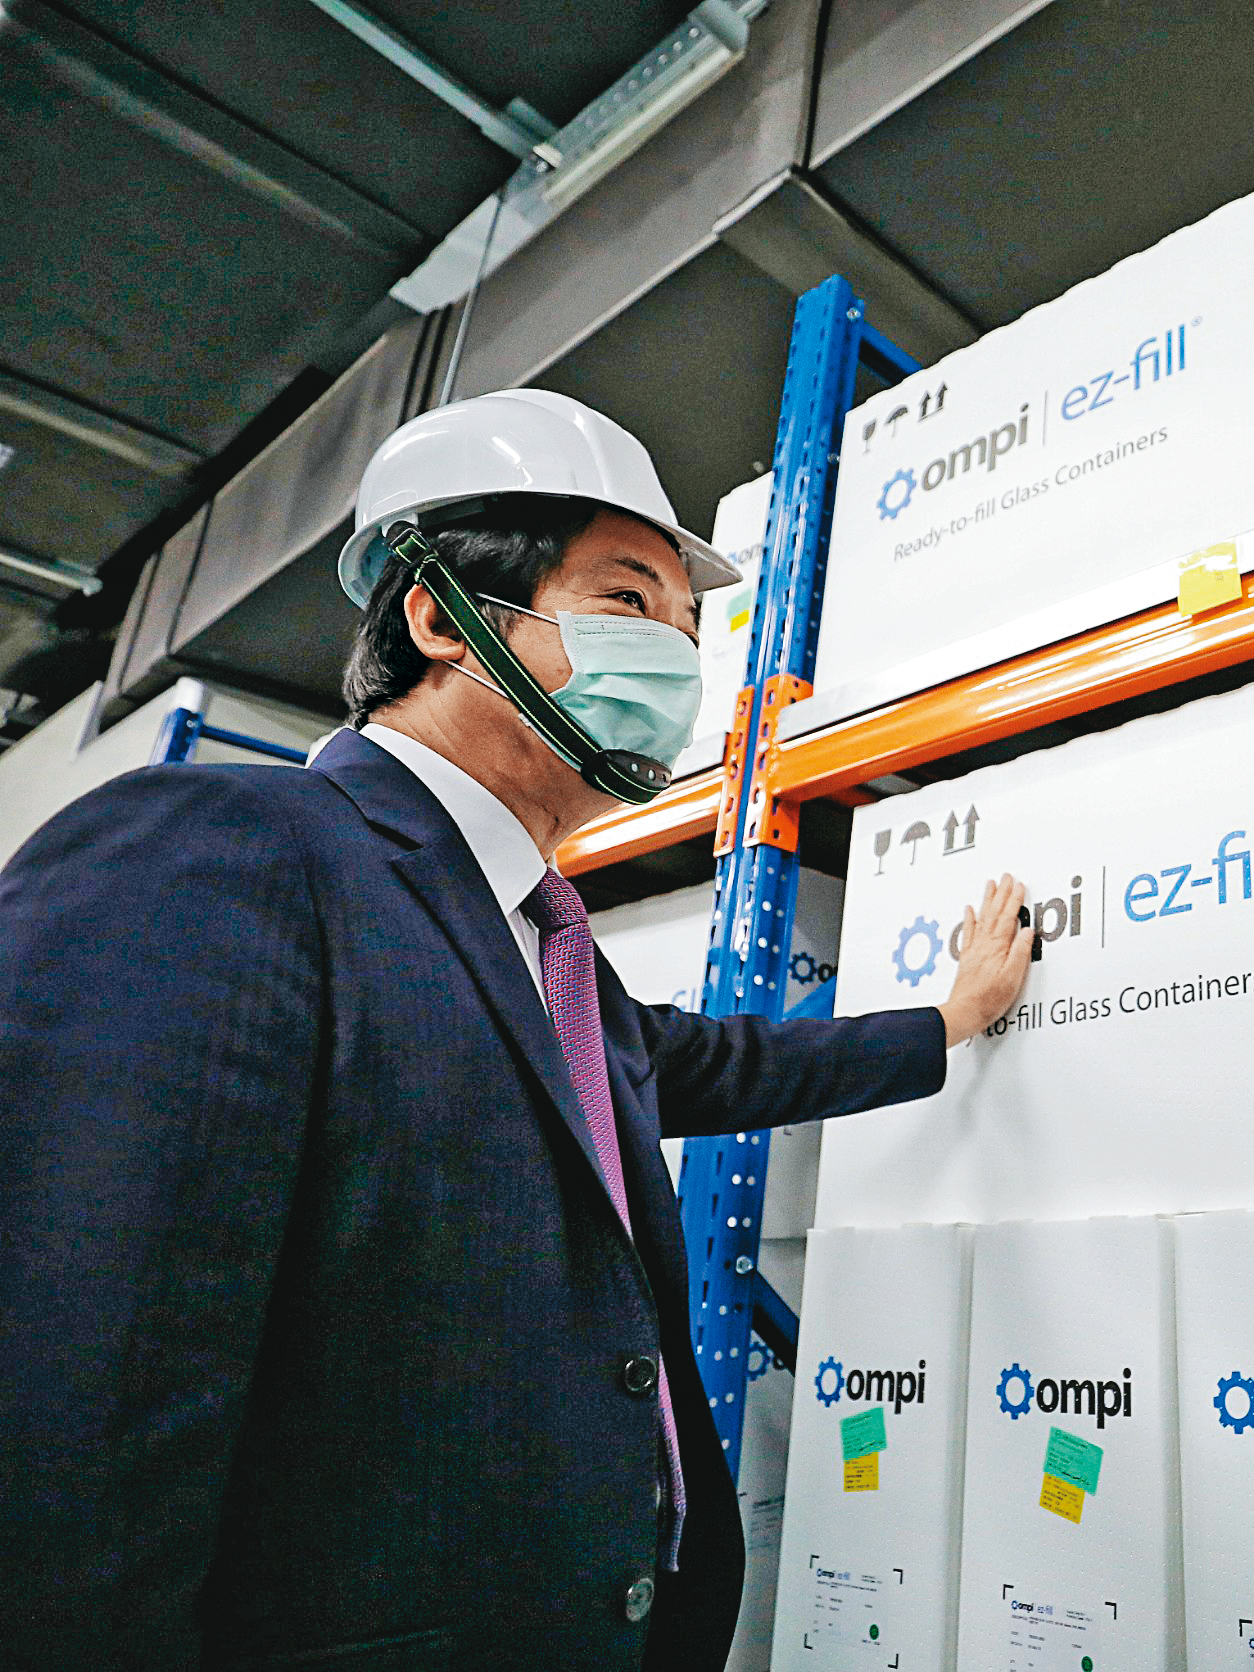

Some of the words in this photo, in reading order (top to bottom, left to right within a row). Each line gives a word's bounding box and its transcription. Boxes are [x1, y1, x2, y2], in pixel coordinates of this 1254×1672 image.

[921, 402, 1030, 492] ompi
[893, 498, 996, 562] Ready-to-fill
[1000, 476, 1049, 511] Glass
[1054, 426, 1169, 486] Containers
[1050, 996, 1111, 1025] Glass
[845, 1359, 927, 1415] ompi
[1036, 1367, 1132, 1429] ompi
